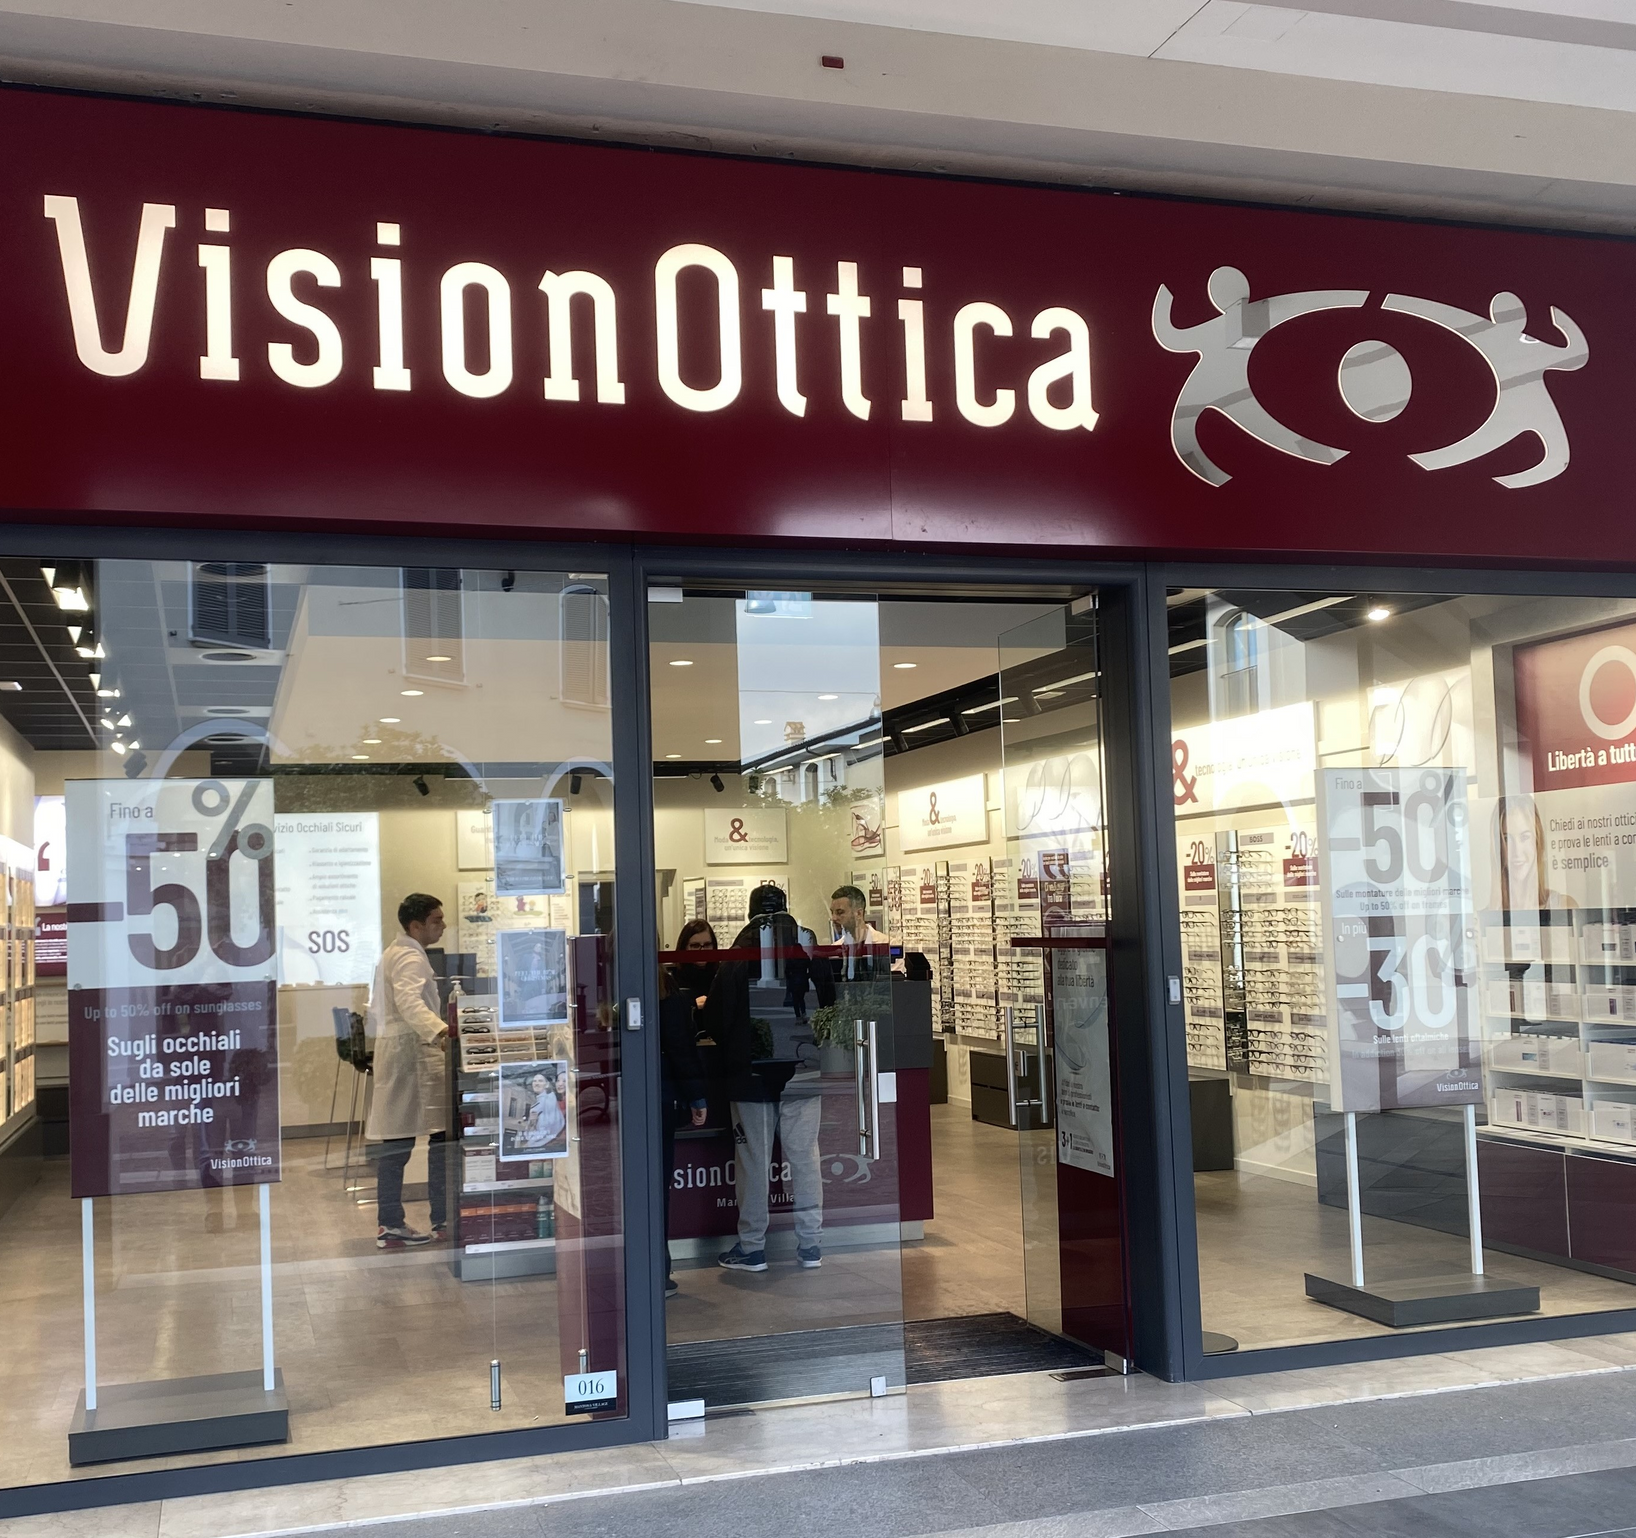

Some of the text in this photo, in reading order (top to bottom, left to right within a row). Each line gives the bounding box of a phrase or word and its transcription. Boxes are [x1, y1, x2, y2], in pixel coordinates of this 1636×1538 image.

[43, 194, 1101, 432] VisionOttica
[1547, 743, 1636, 772] Libertà a tutt
[1335, 777, 1363, 790] Fino a
[110, 803, 154, 819] Fino a
[297, 822, 333, 833] Occhiali
[336, 821, 363, 833] Sicuri
[729, 818, 749, 842] &
[1549, 817, 1575, 832] Chiedi
[1577, 817, 1585, 830] ai
[1587, 814, 1612, 829] nostri
[1551, 839, 1556, 850] e
[1558, 837, 1581, 852] prova
[1583, 835, 1591, 848] le
[1592, 833, 1612, 847] lenti
[1614, 835, 1620, 845] a
[1552, 852, 1609, 872] è semplice
[1336, 889, 1354, 899] Sulle
[1355, 888, 1393, 898] montature
[1414, 886, 1441, 898] migliori
[1360, 902, 1370, 912] Up
[1371, 902, 1379, 910] to
[1341, 922, 1367, 937] In più
[308, 930, 350, 954] SOS
[84, 1001, 262, 1021] Up to 50% off on sunglasses
[107, 1029, 241, 1060] Sugli occhiali
[1373, 1032, 1449, 1045] Sulle lenti oftalmiche
[139, 1055, 211, 1079] da sole
[110, 1076, 240, 1105] delle migliori
[1437, 1081, 1479, 1092] VisionOttica
[138, 1103, 214, 1128] marche
[211, 1155, 272, 1170] VisionOttica
[578, 1377, 605, 1396] 016
